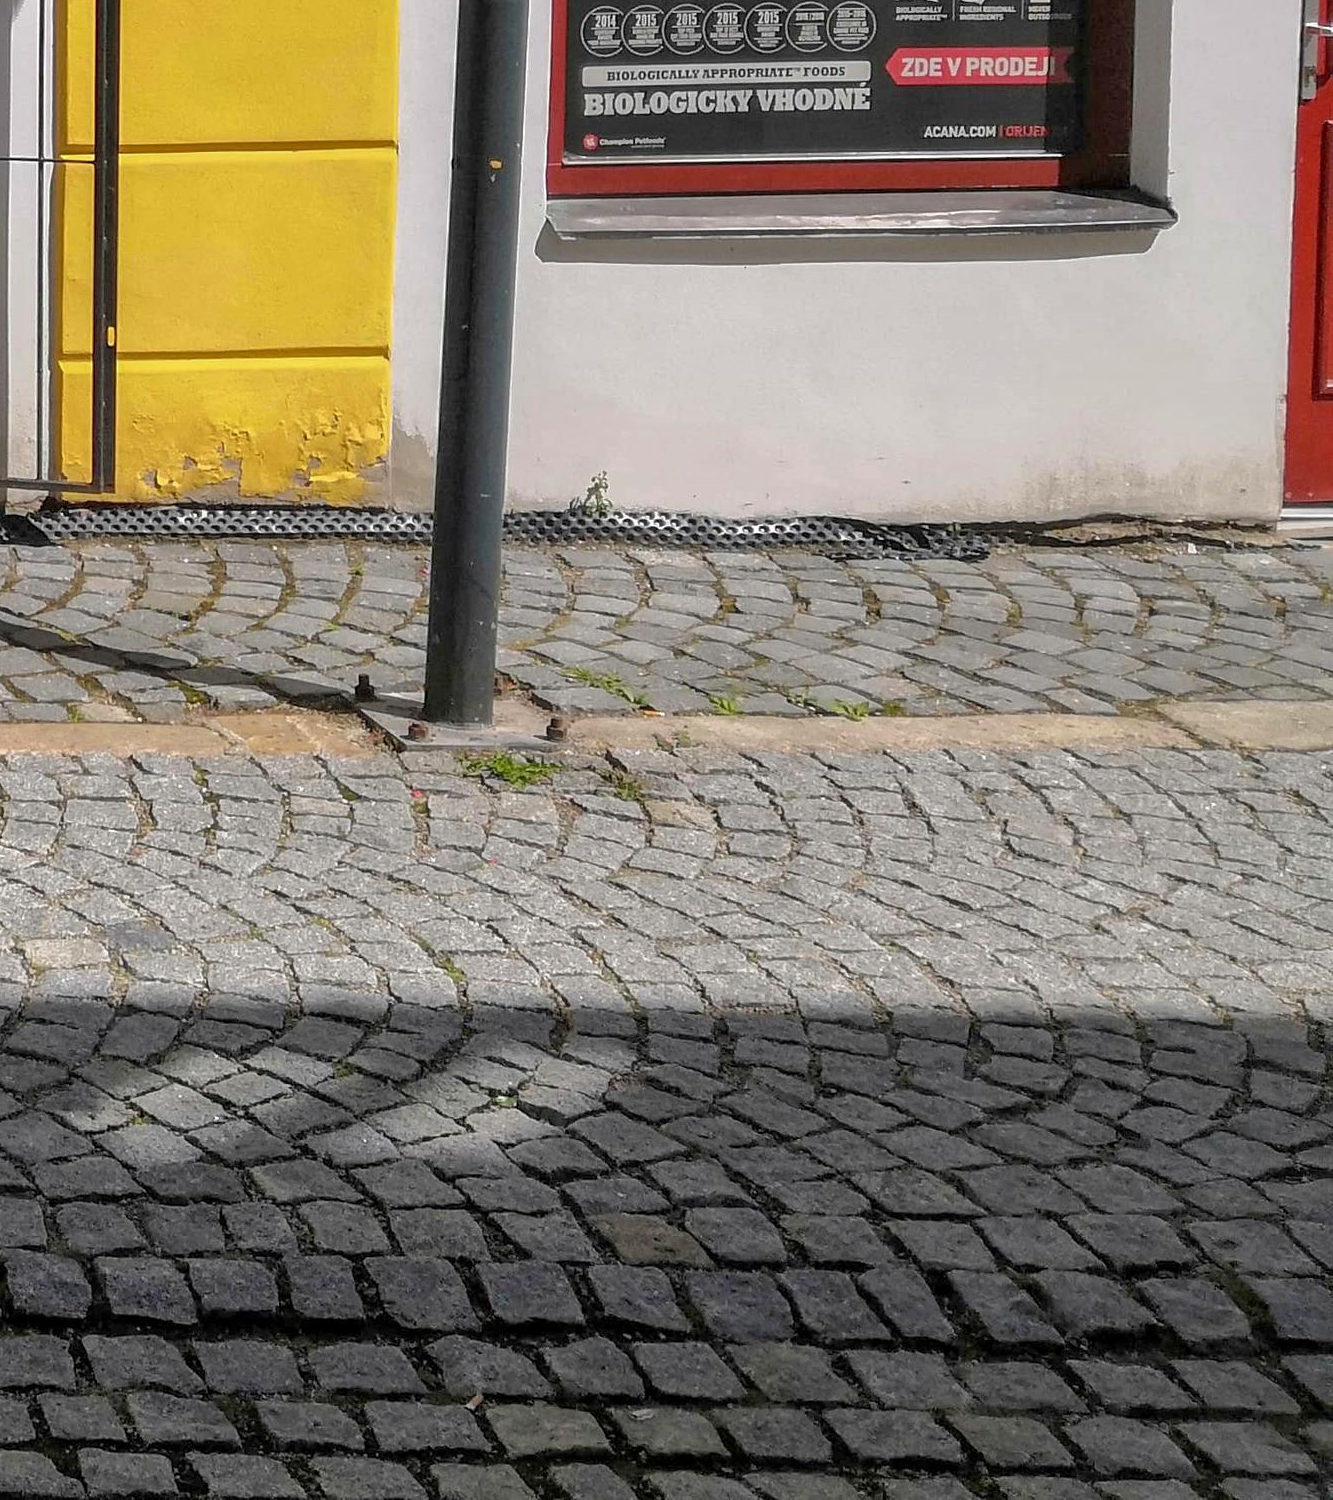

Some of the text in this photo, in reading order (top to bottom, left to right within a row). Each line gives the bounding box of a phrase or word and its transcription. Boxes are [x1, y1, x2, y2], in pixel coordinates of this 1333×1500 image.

[595, 14, 617, 28] 2014
[635, 14, 657, 27] 2015
[676, 13, 698, 26] 2015
[716, 12, 738, 25] 2015
[758, 11, 780, 24] 2015
[900, 56, 943, 77] ZDE
[946, 56, 962, 77] V
[607, 70, 700, 82] BIOLOGICALLY
[803, 66, 846, 78] FOODS
[583, 82, 871, 117] BIOLOGICKY VHODNÉ
[923, 125, 997, 138] ACANA.COM
